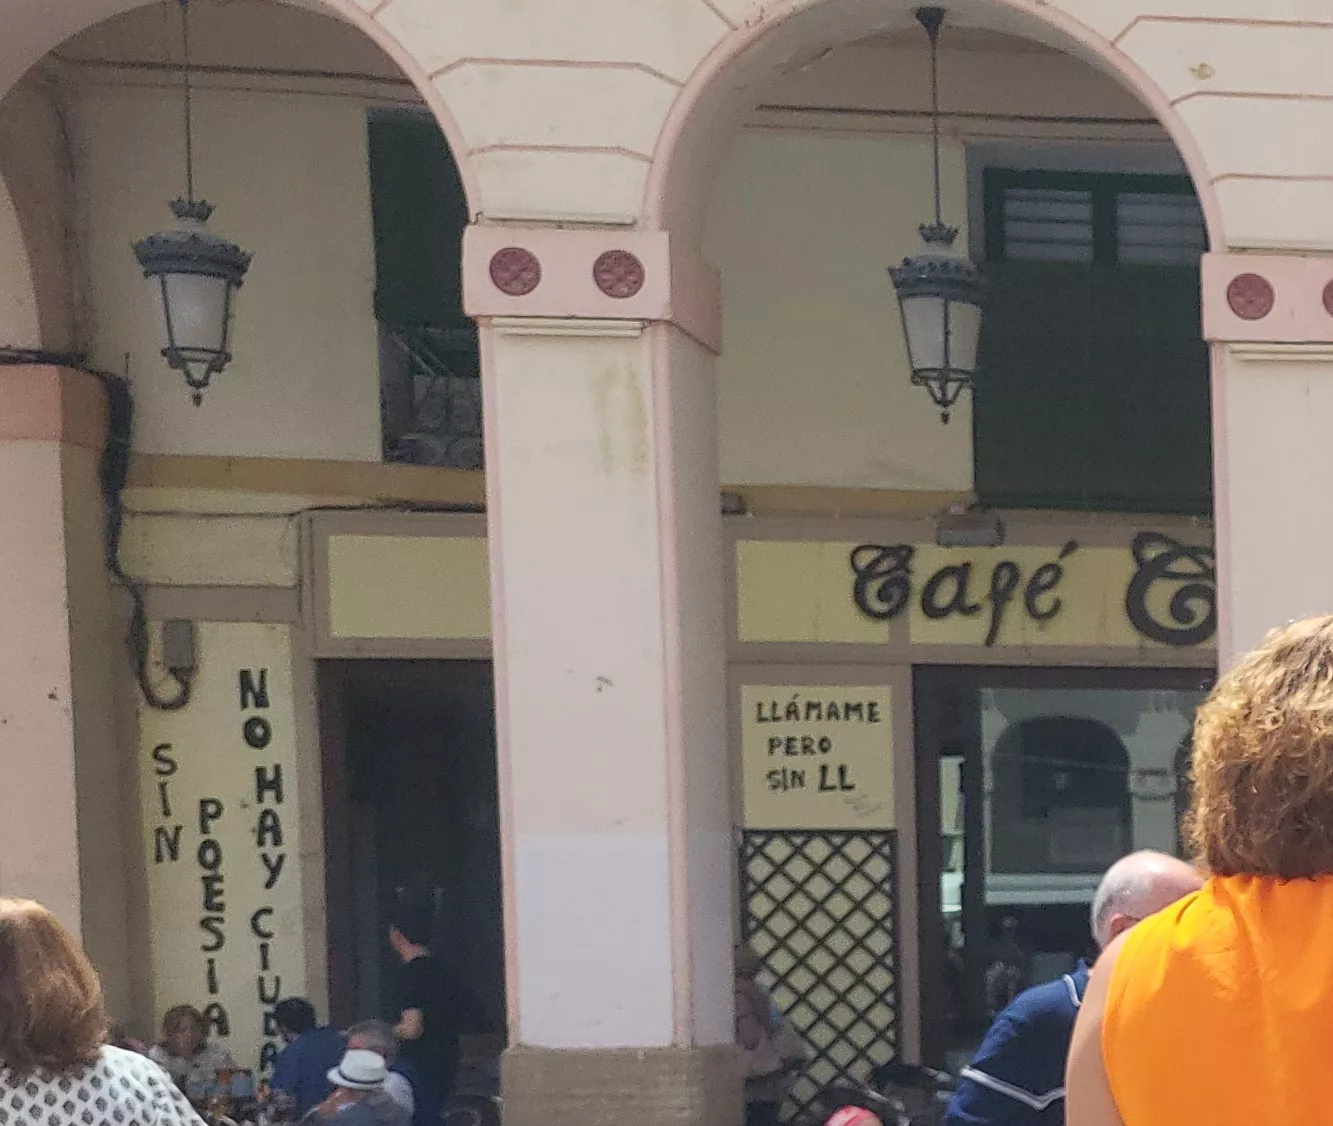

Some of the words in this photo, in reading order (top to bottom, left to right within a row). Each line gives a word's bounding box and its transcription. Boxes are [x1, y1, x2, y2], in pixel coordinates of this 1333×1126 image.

[850, 540, 1078, 647] Café
[239, 668, 272, 749] NO
[756, 694, 881, 723] LLÁMAME
[767, 736, 832, 756] PERO
[152, 742, 183, 864] SIN
[766, 767, 806, 791] SIN
[818, 764, 856, 793] LL
[255, 763, 286, 889] HAY
[198, 798, 230, 1037] POESIA
